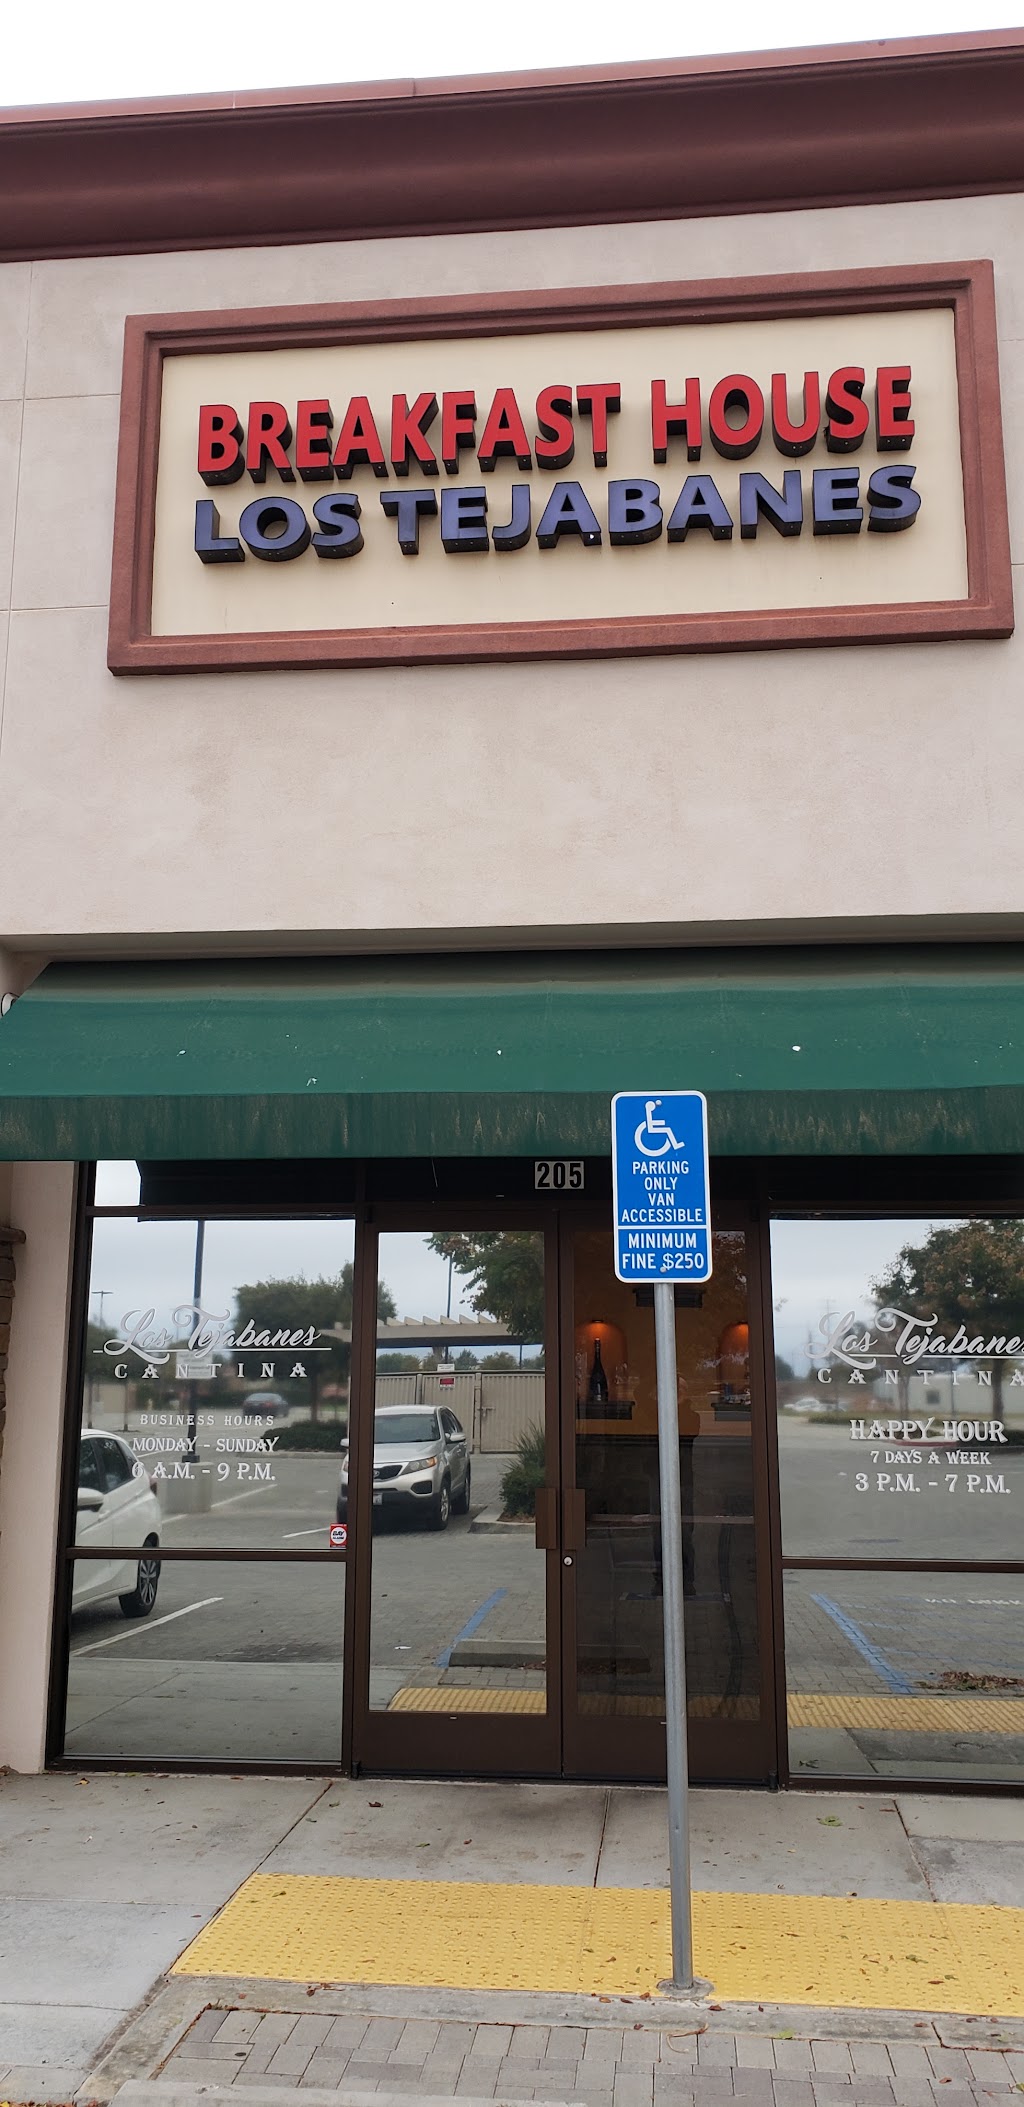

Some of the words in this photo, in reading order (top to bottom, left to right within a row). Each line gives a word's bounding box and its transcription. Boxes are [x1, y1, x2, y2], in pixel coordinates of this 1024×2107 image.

[197, 382, 622, 486] BREAKFAST
[651, 366, 916, 464] HOUSE
[195, 492, 365, 564] LOS
[380, 465, 922, 555] TEJABANES
[536, 1162, 582, 1188] 205
[632, 1160, 689, 1175] PARKING
[644, 1177, 678, 1190] ONLY
[648, 1193, 675, 1206] VAN
[621, 1208, 703, 1222] ACCESSIBLE
[628, 1233, 697, 1249] MINIMUM
[622, 1253, 656, 1270] FINE
[662, 1252, 704, 1270] $250
[103, 1308, 172, 1365] Los
[172, 1304, 321, 1358] Tejabanes
[804, 1310, 878, 1370] Los
[875, 1307, 1024, 1365] Tejabane
[114, 1362, 307, 1379] CANTINA
[817, 1368, 1024, 1386] CANTINA
[140, 1414, 215, 1426] BUSINESS
[224, 1415, 275, 1426] HOURS
[850, 1417, 936, 1441] HAPPY
[943, 1420, 1008, 1443] HOUR
[132, 1436, 199, 1452] MONDAY
[216, 1436, 280, 1452] SUNDAY
[870, 1450, 880, 1464] 7
[884, 1450, 923, 1465] DAYS
[928, 1451, 941, 1465] A
[946, 1449, 992, 1465] WEEK
[131, 1461, 145, 1478] 6
[153, 1461, 196, 1479] A.M.
[217, 1462, 231, 1481] 9
[237, 1463, 276, 1481] P.M.
[855, 1472, 869, 1492] 3
[876, 1472, 921, 1492] P.M.
[945, 1474, 958, 1492] 7
[967, 1474, 1012, 1494] P.M.
